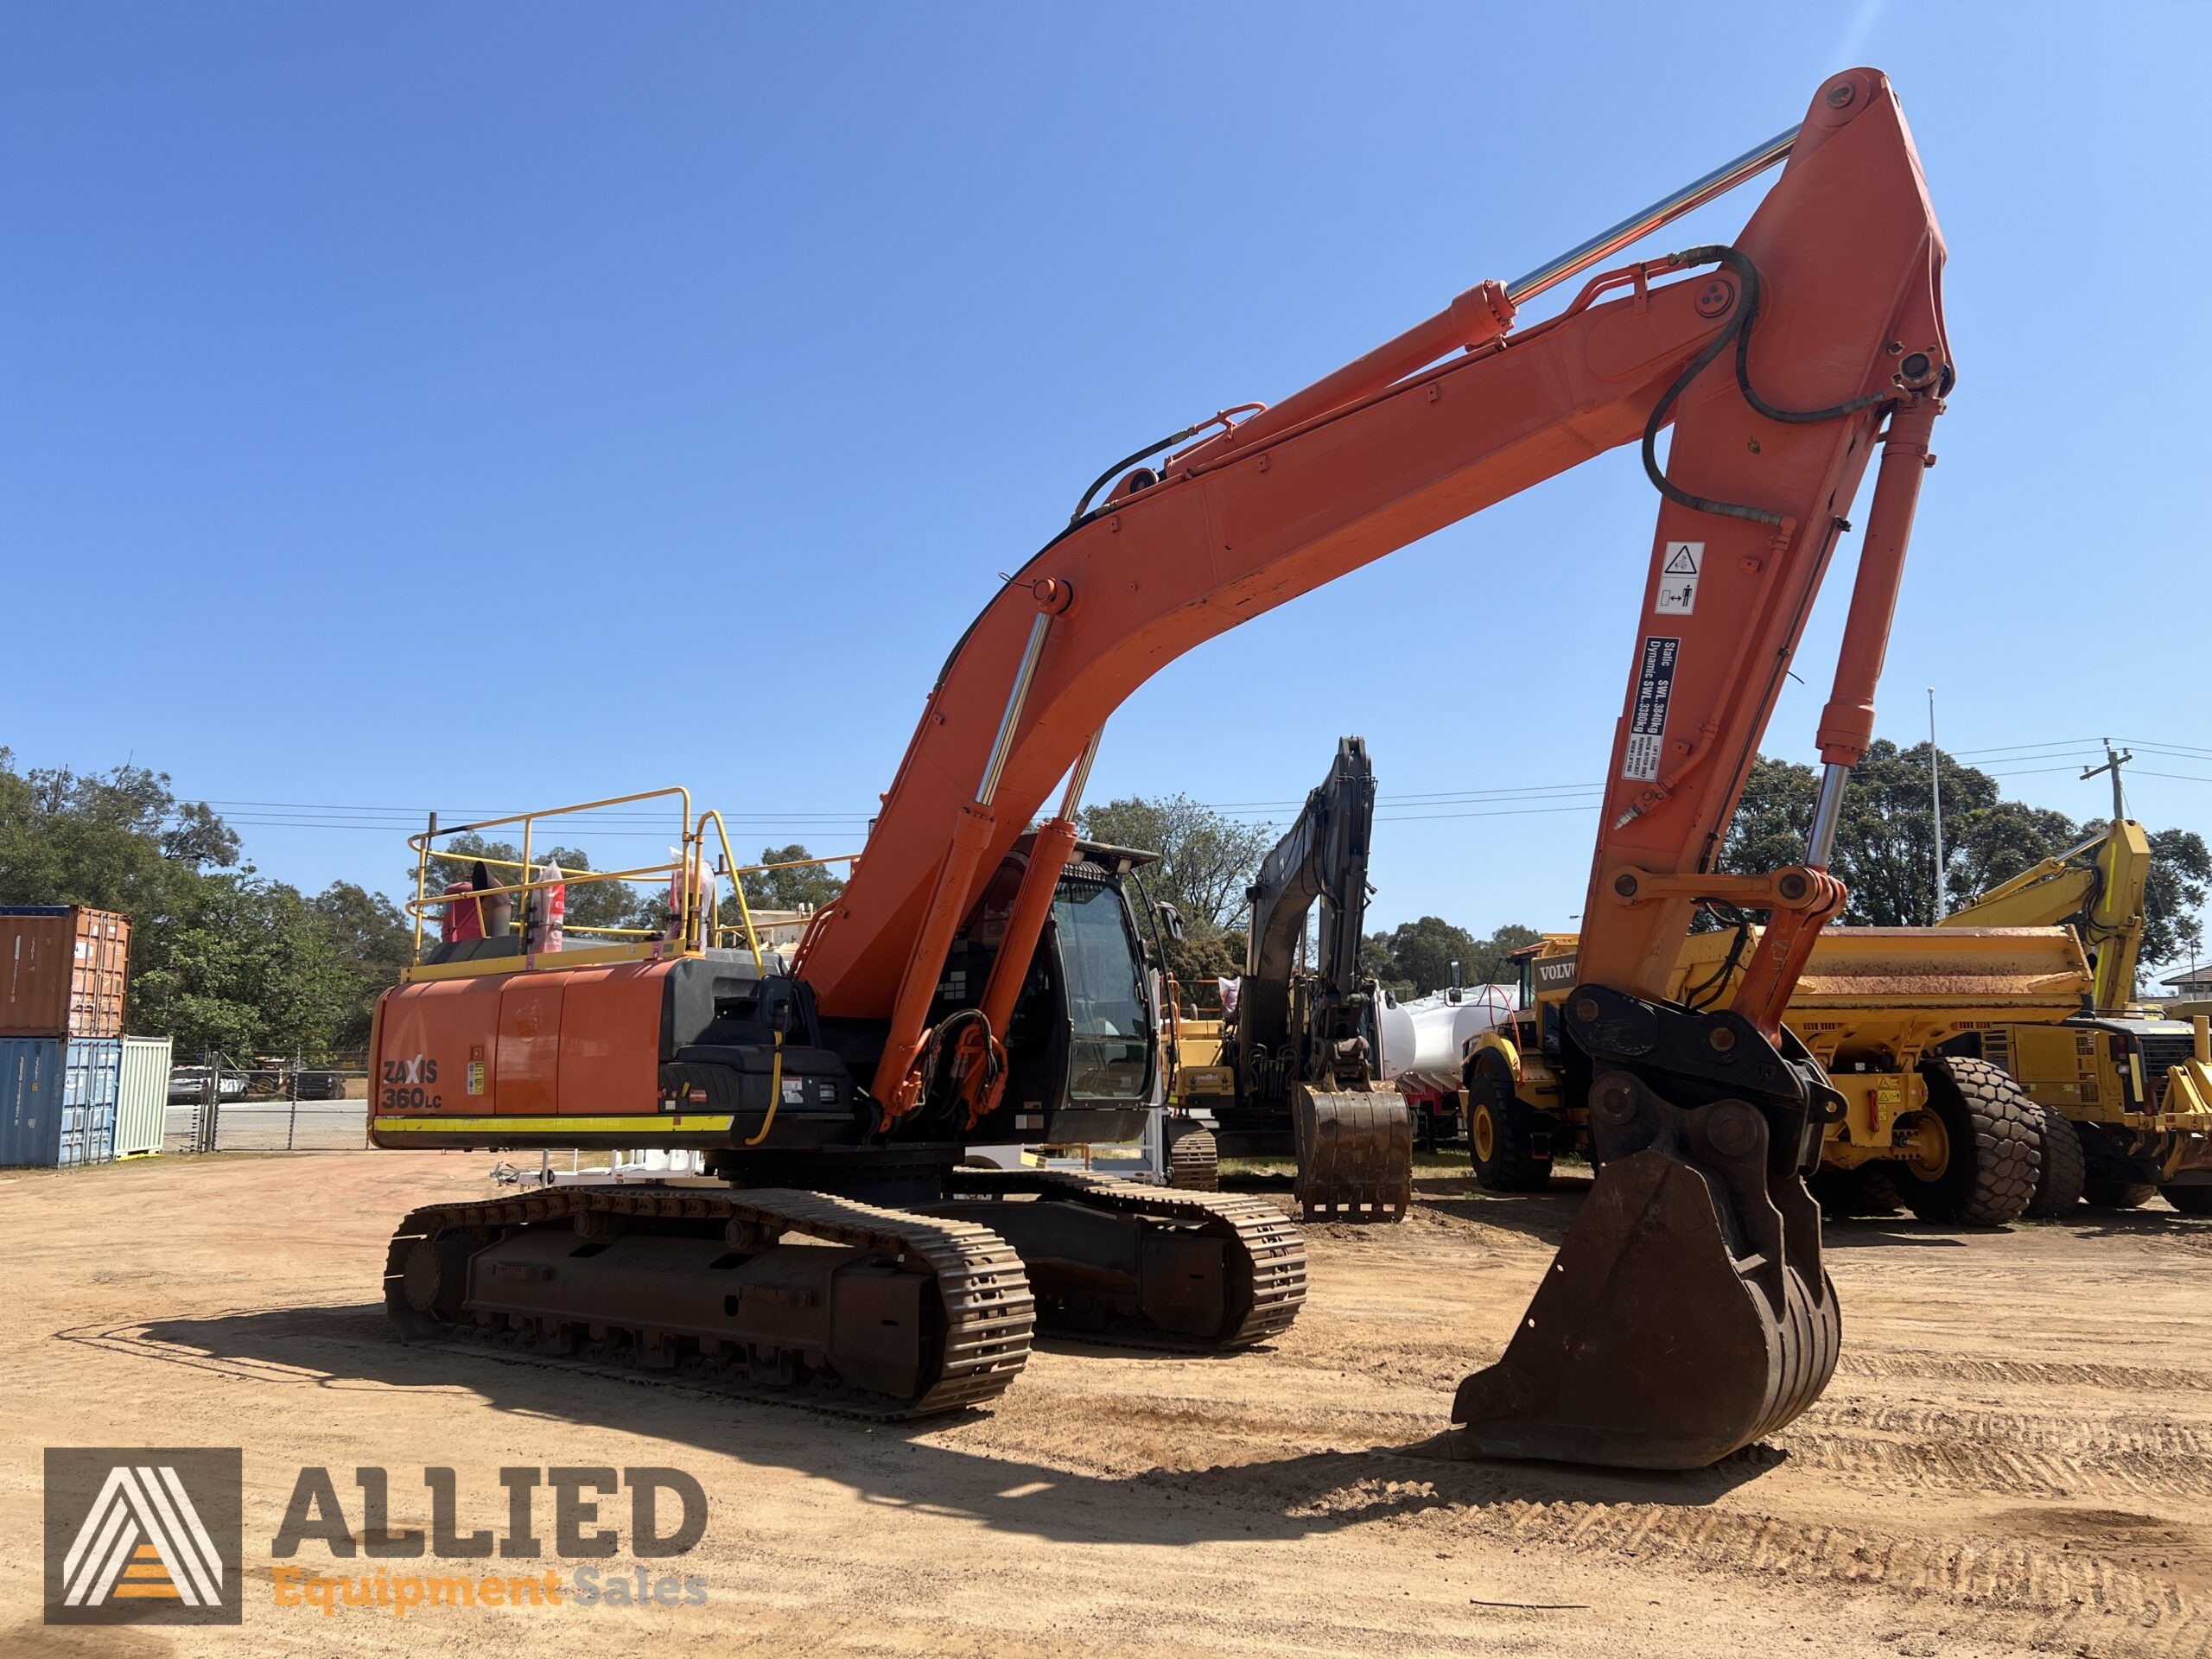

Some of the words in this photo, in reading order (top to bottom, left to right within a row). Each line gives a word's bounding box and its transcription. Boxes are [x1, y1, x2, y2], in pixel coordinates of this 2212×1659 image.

[1645, 641, 1661, 678] Dynamic
[1662, 642, 1675, 667] Static
[384, 1054, 437, 1084] ZAXIS
